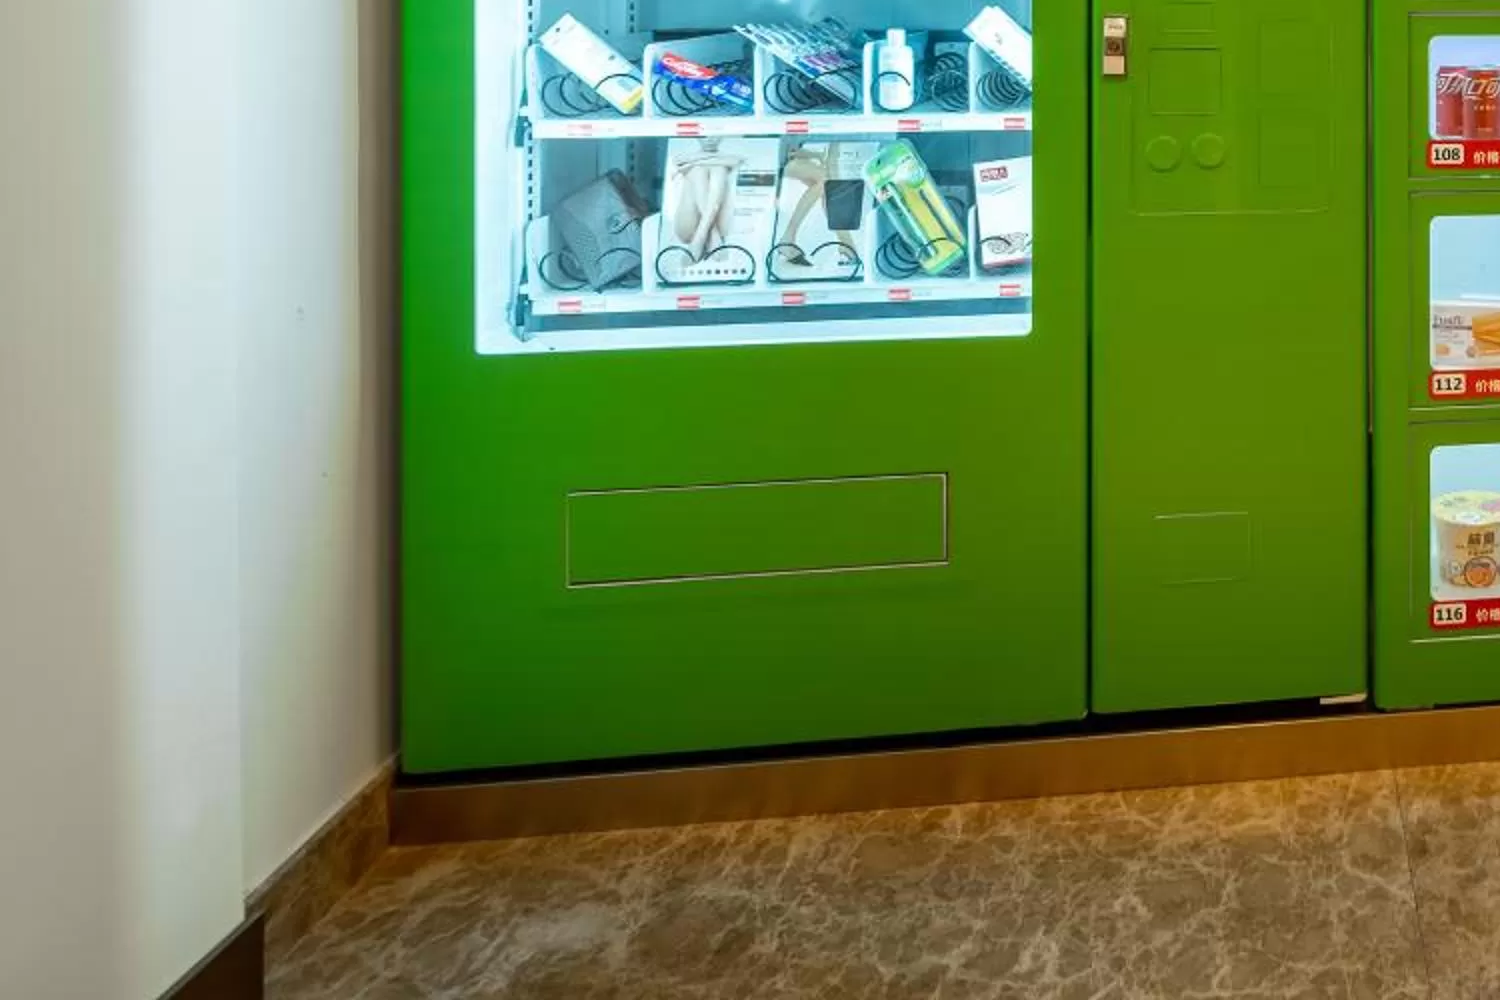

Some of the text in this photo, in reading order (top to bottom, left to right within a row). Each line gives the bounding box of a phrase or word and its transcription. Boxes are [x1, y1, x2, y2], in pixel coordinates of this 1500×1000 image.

[1433, 148, 1460, 161] 108
[1436, 378, 1462, 391] 112
[1436, 608, 1463, 621] 116
